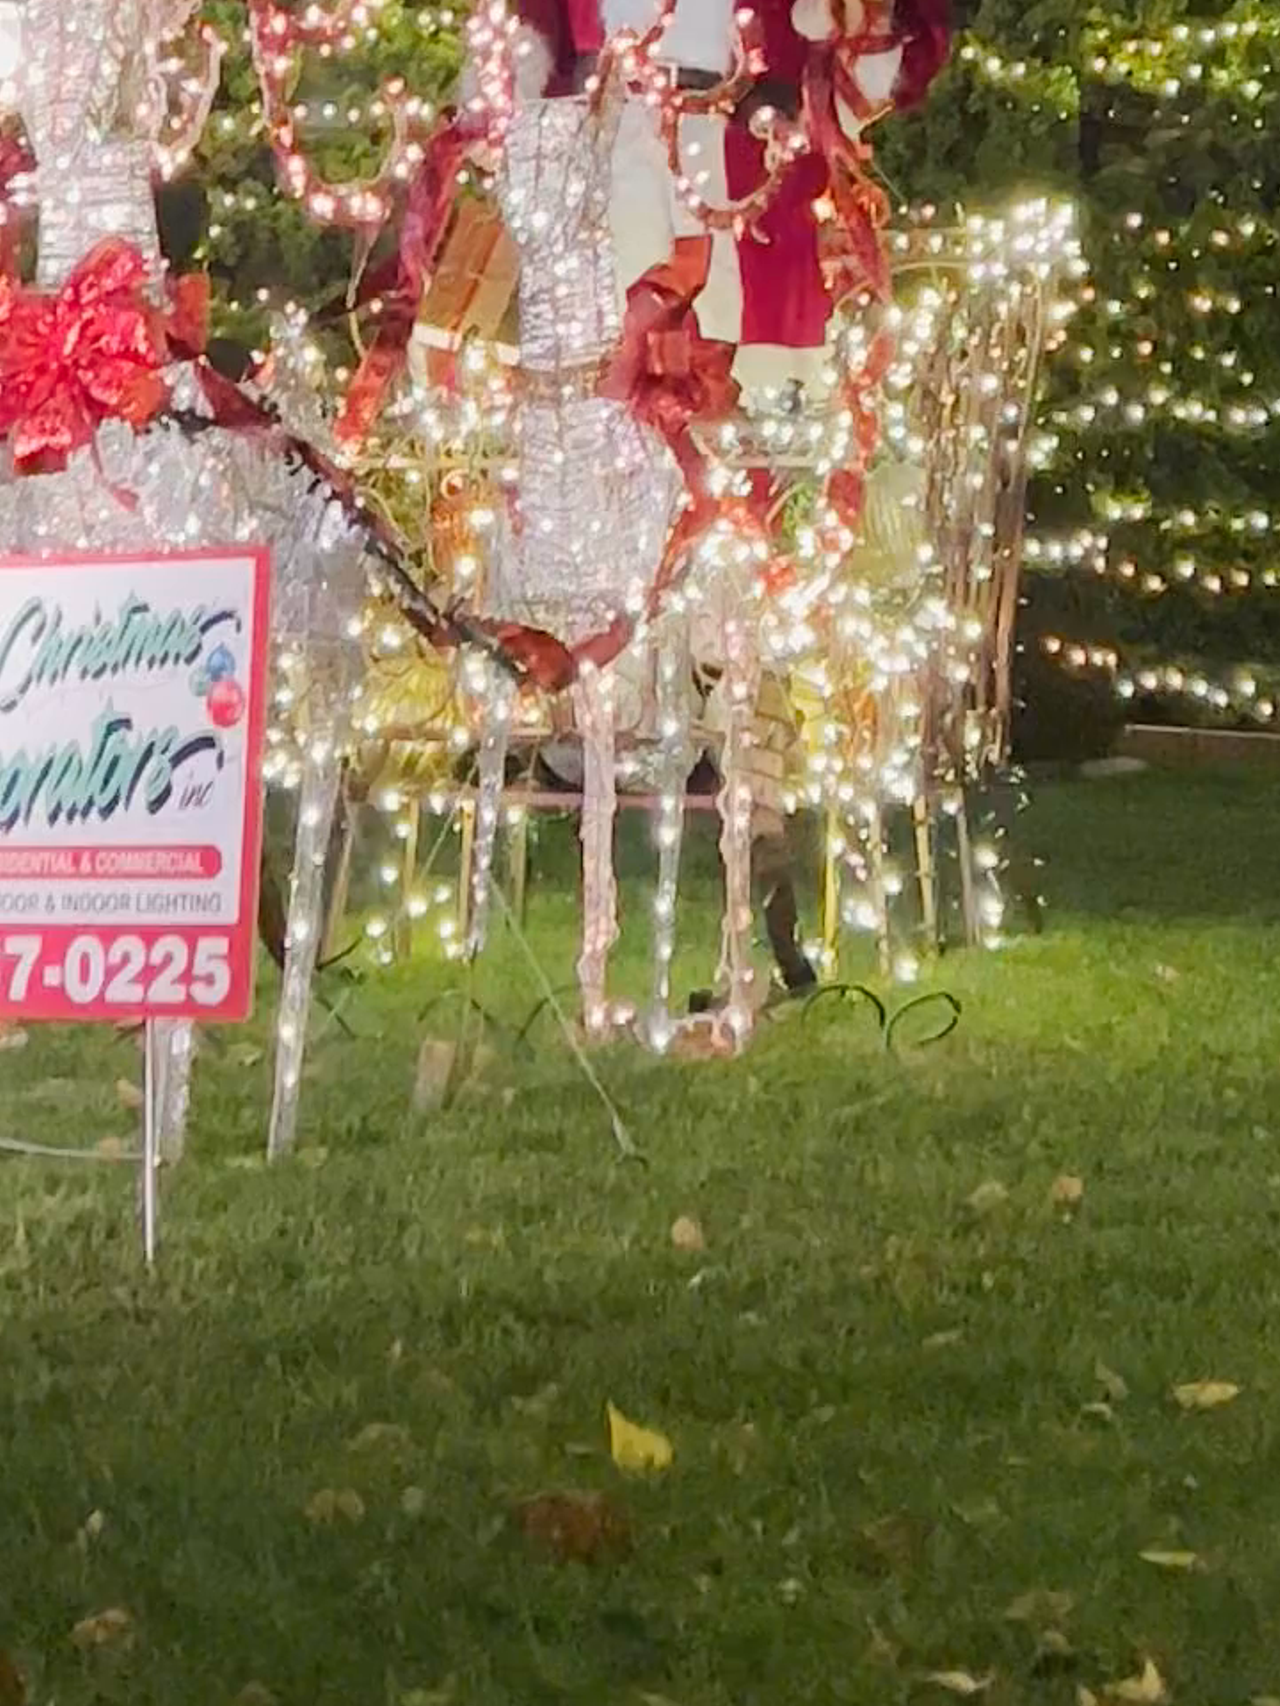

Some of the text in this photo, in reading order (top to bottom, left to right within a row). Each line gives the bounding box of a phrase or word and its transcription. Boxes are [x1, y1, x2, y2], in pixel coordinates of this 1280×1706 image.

[78, 850, 93, 874] &
[95, 850, 204, 874] COMMERCIAL
[44, 892, 55, 913] &
[61, 892, 131, 914] INDOOR
[135, 891, 221, 914] LIGHTING
